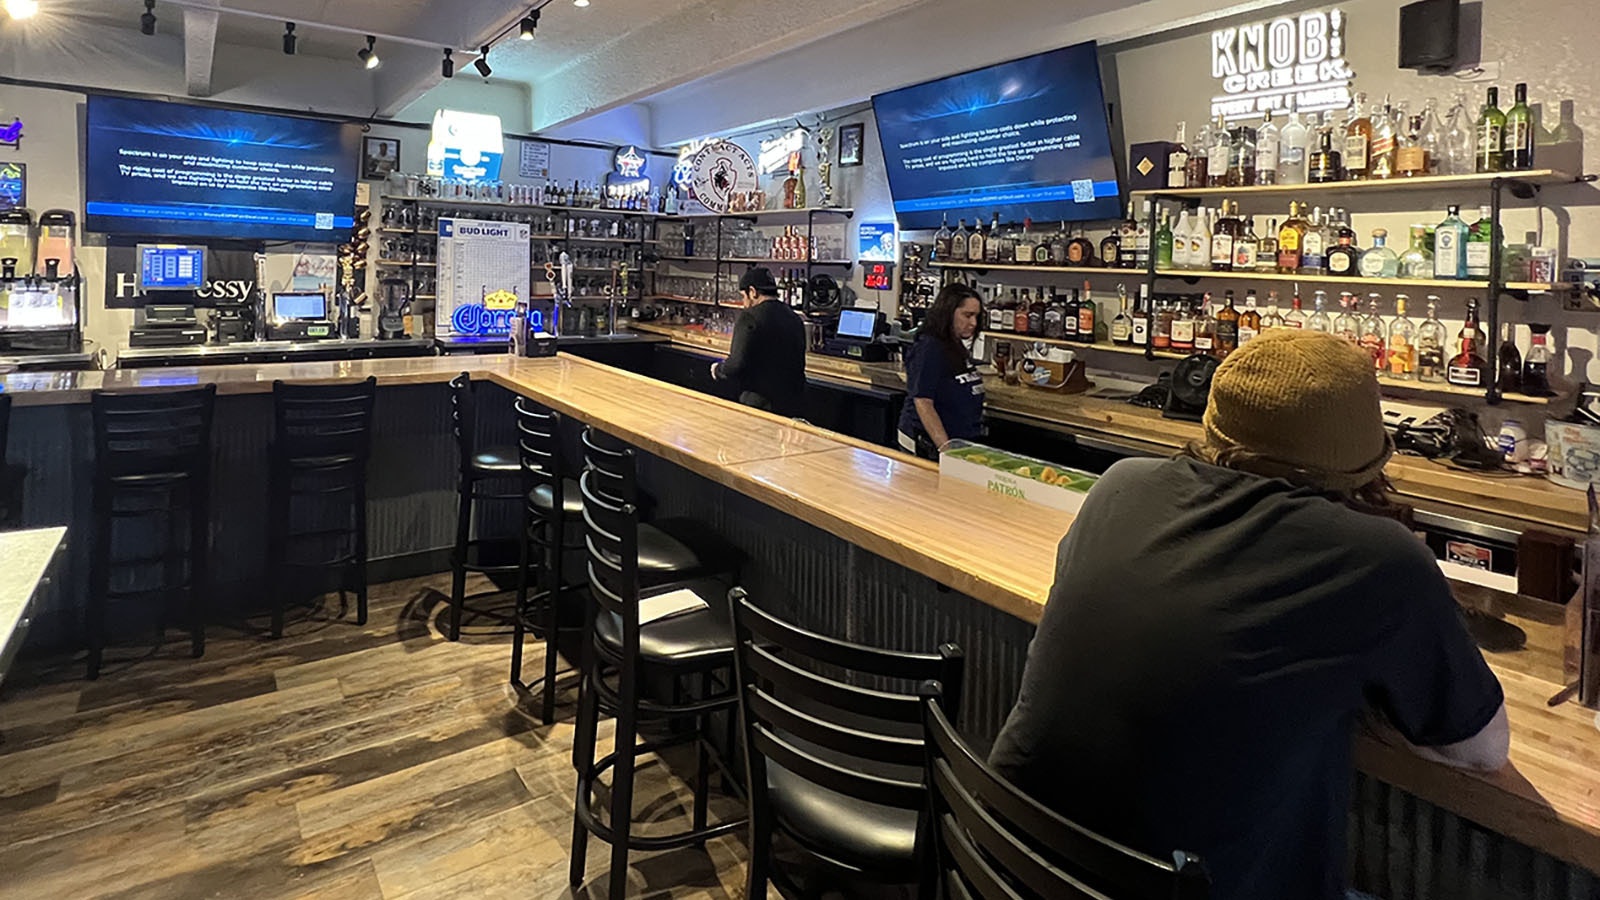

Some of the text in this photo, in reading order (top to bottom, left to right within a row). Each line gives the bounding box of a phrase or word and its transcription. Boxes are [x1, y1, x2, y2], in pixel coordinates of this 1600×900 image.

[738, 153, 754, 178] ACTS
[699, 192, 724, 212] COMM
[460, 226, 508, 237] BUD LIGHT
[115, 272, 254, 302] Hessy
[452, 302, 545, 334] Coroa
